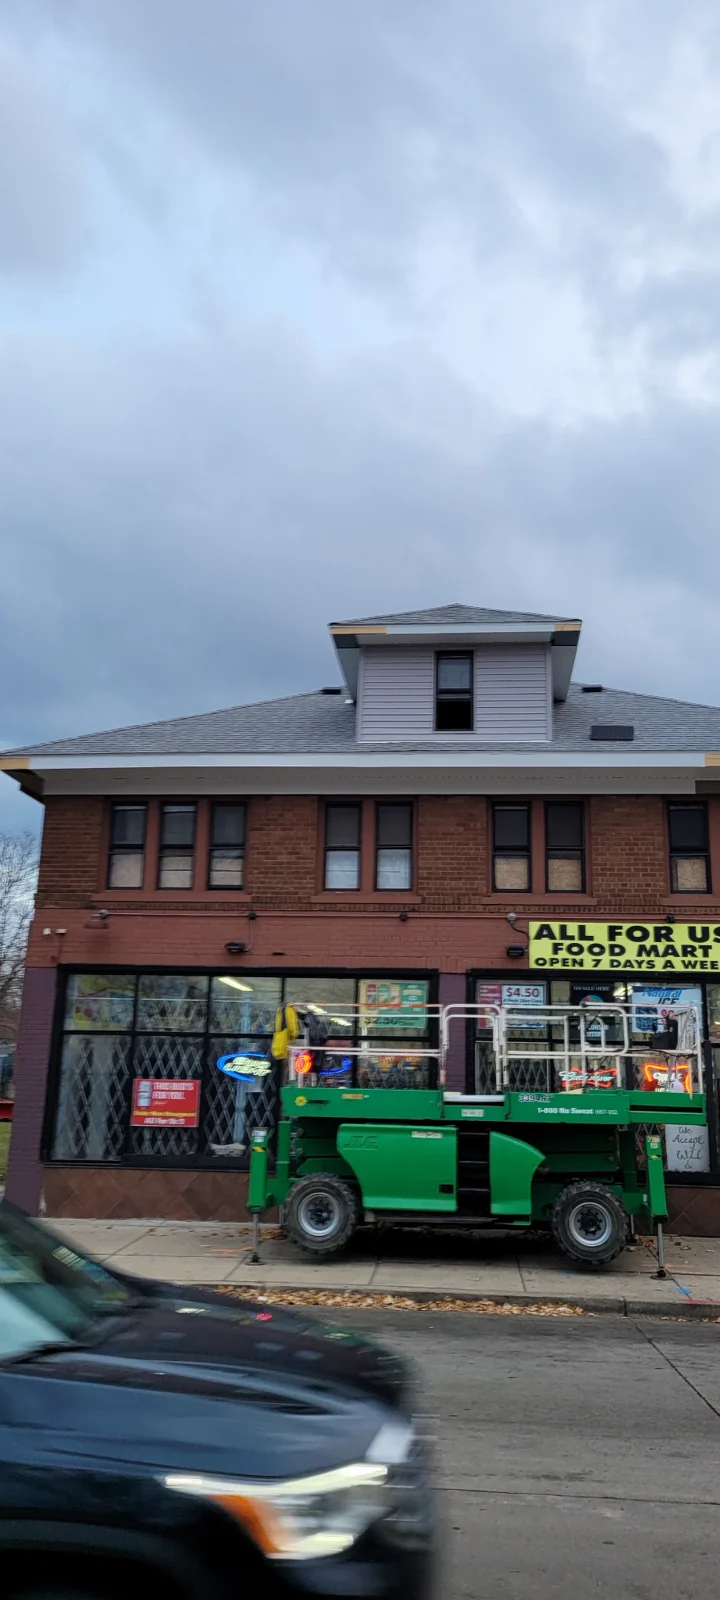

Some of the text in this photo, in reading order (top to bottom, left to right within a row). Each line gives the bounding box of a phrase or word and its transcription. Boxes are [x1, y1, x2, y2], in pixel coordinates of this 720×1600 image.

[533, 924, 594, 941] ALL
[607, 925, 675, 943] FOR
[552, 943, 713, 958] FOOD MART
[534, 957, 720, 970] OPEN 7 DAYS A WEE
[505, 987, 540, 999] $4.50
[642, 987, 683, 998] Natural
[672, 1134, 705, 1149] Accept
